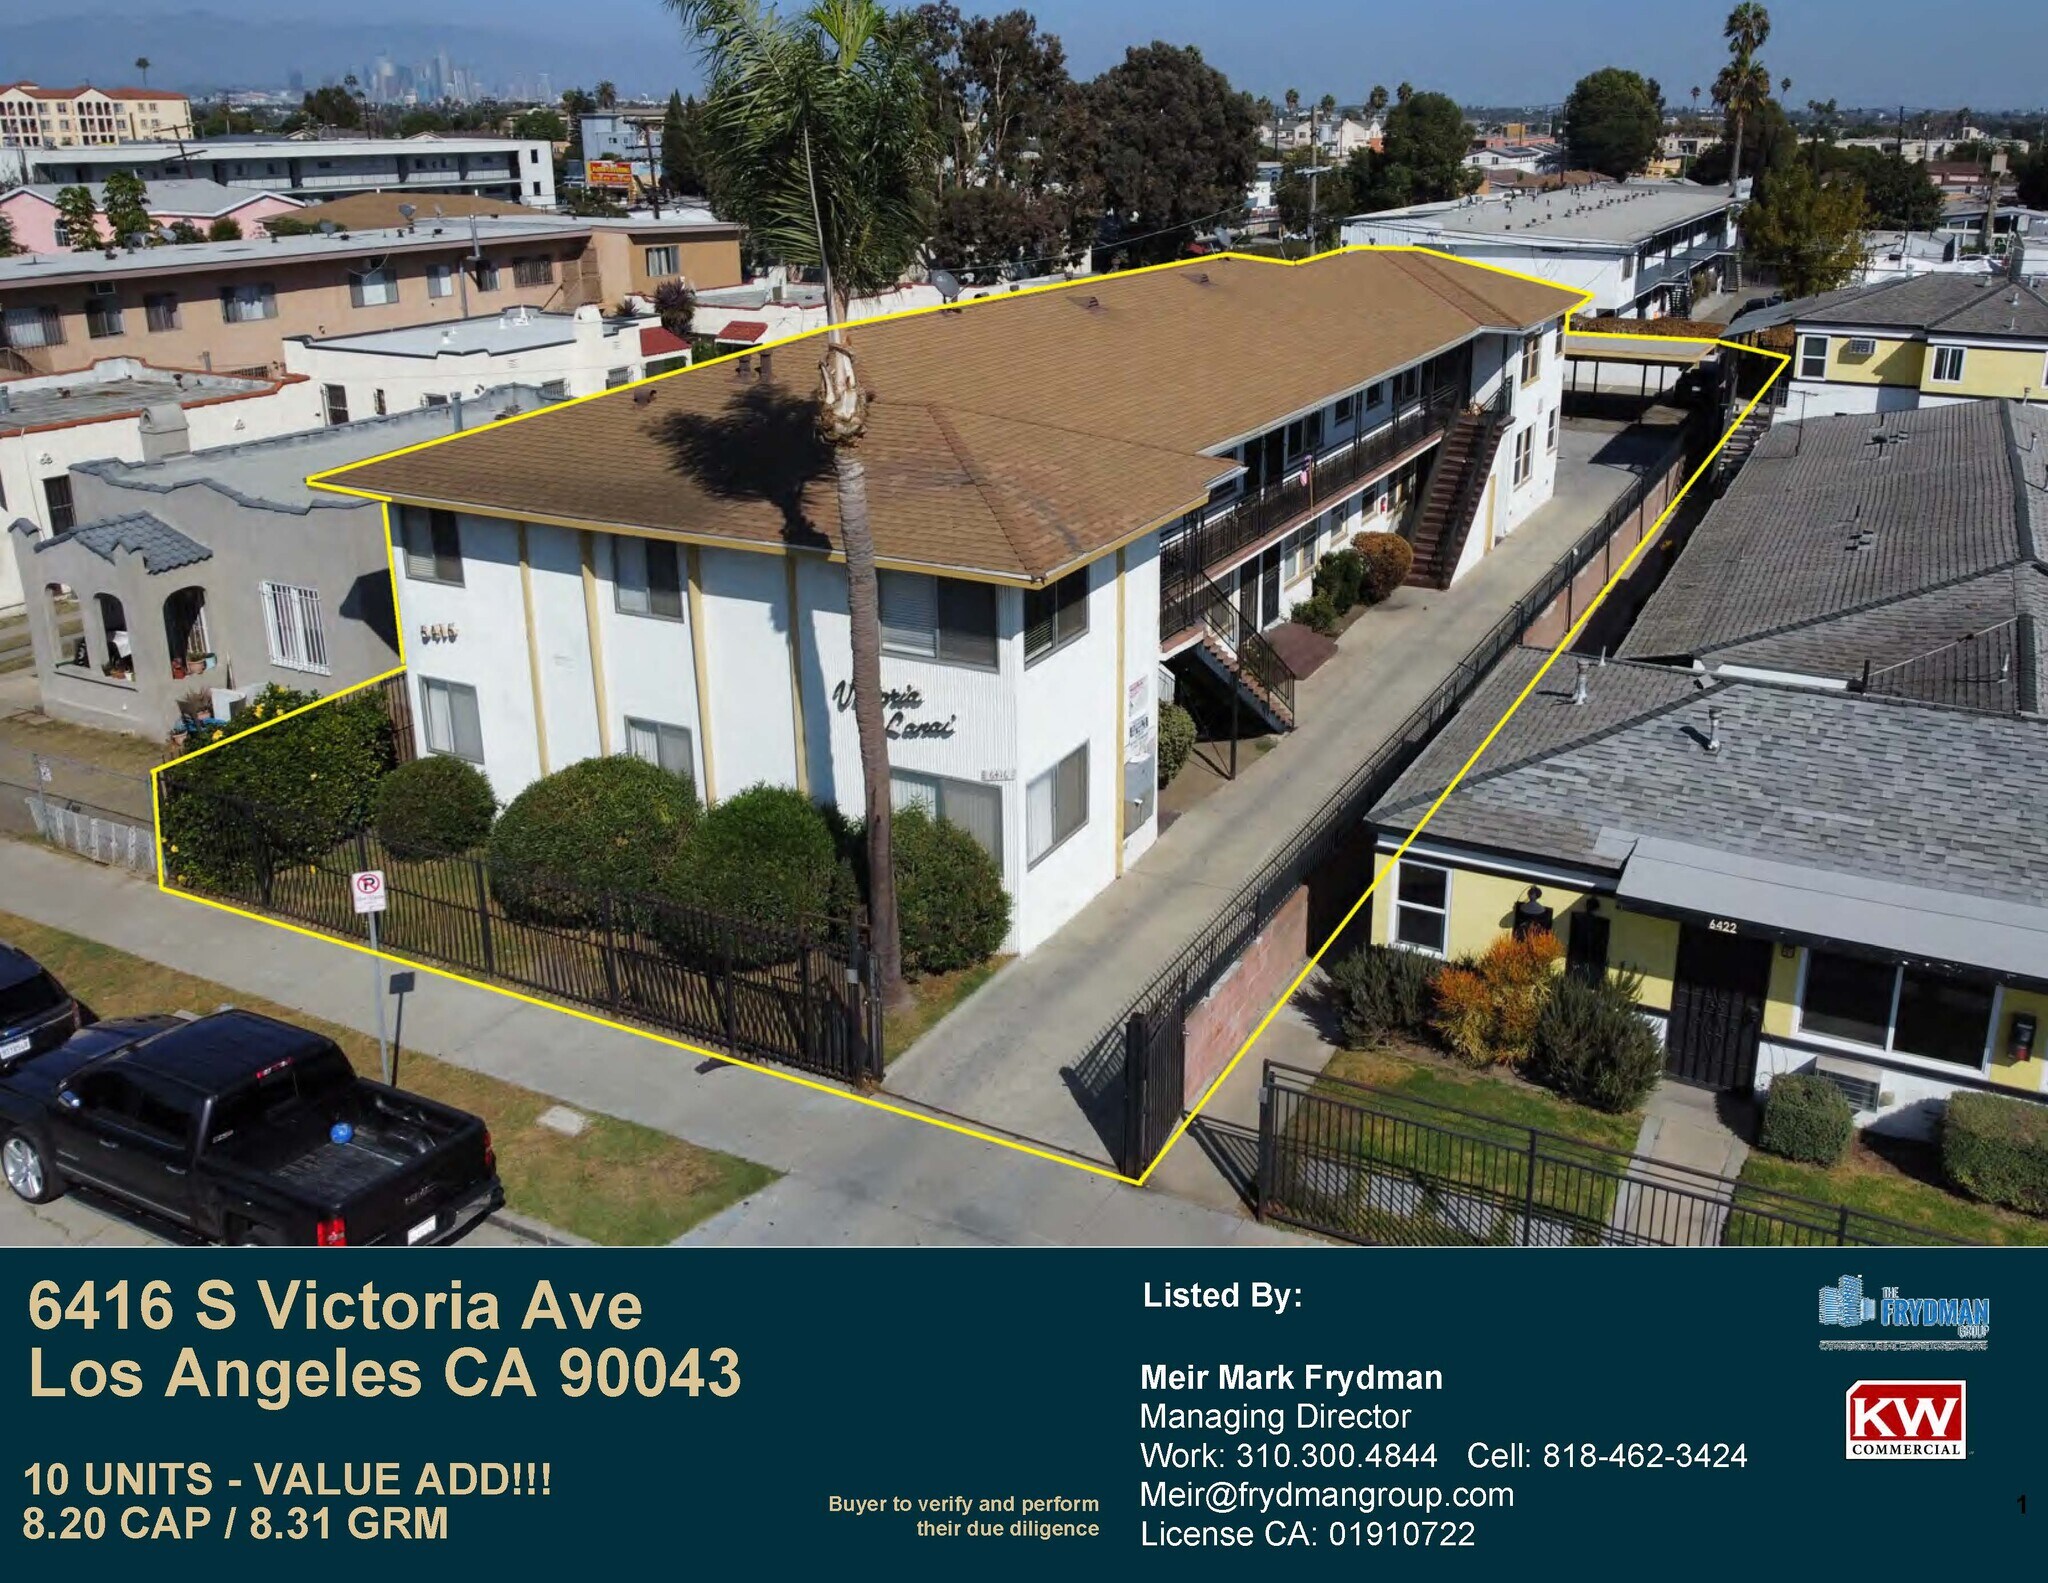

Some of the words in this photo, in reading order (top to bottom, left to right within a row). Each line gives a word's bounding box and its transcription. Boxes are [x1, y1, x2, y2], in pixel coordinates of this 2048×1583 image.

[832, 679, 924, 708] Voria
[885, 711, 957, 738] Lanai
[1709, 918, 1737, 934] 6422
